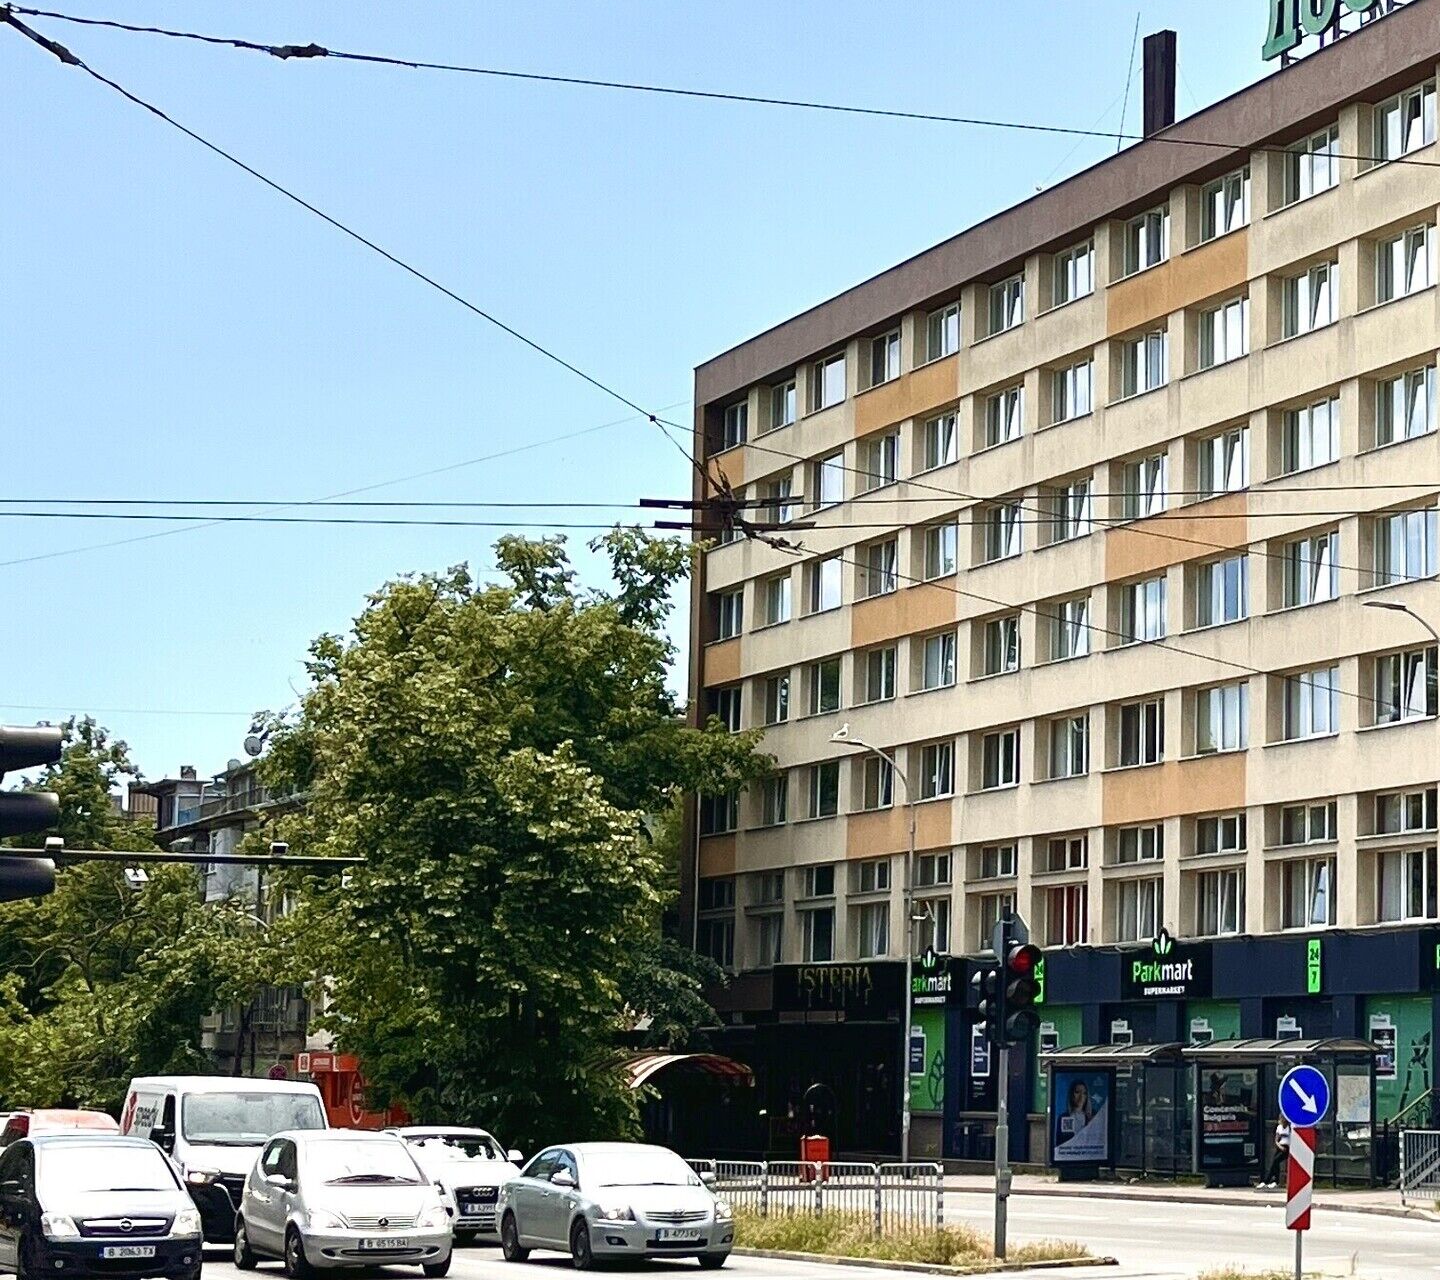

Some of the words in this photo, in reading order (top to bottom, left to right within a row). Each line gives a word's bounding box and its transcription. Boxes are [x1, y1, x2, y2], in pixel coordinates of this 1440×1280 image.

[1309, 948, 1320, 961] 24
[1132, 959, 1193, 983] Parkmart
[1311, 972, 1317, 984] 7
[911, 972, 952, 992] arkmart
